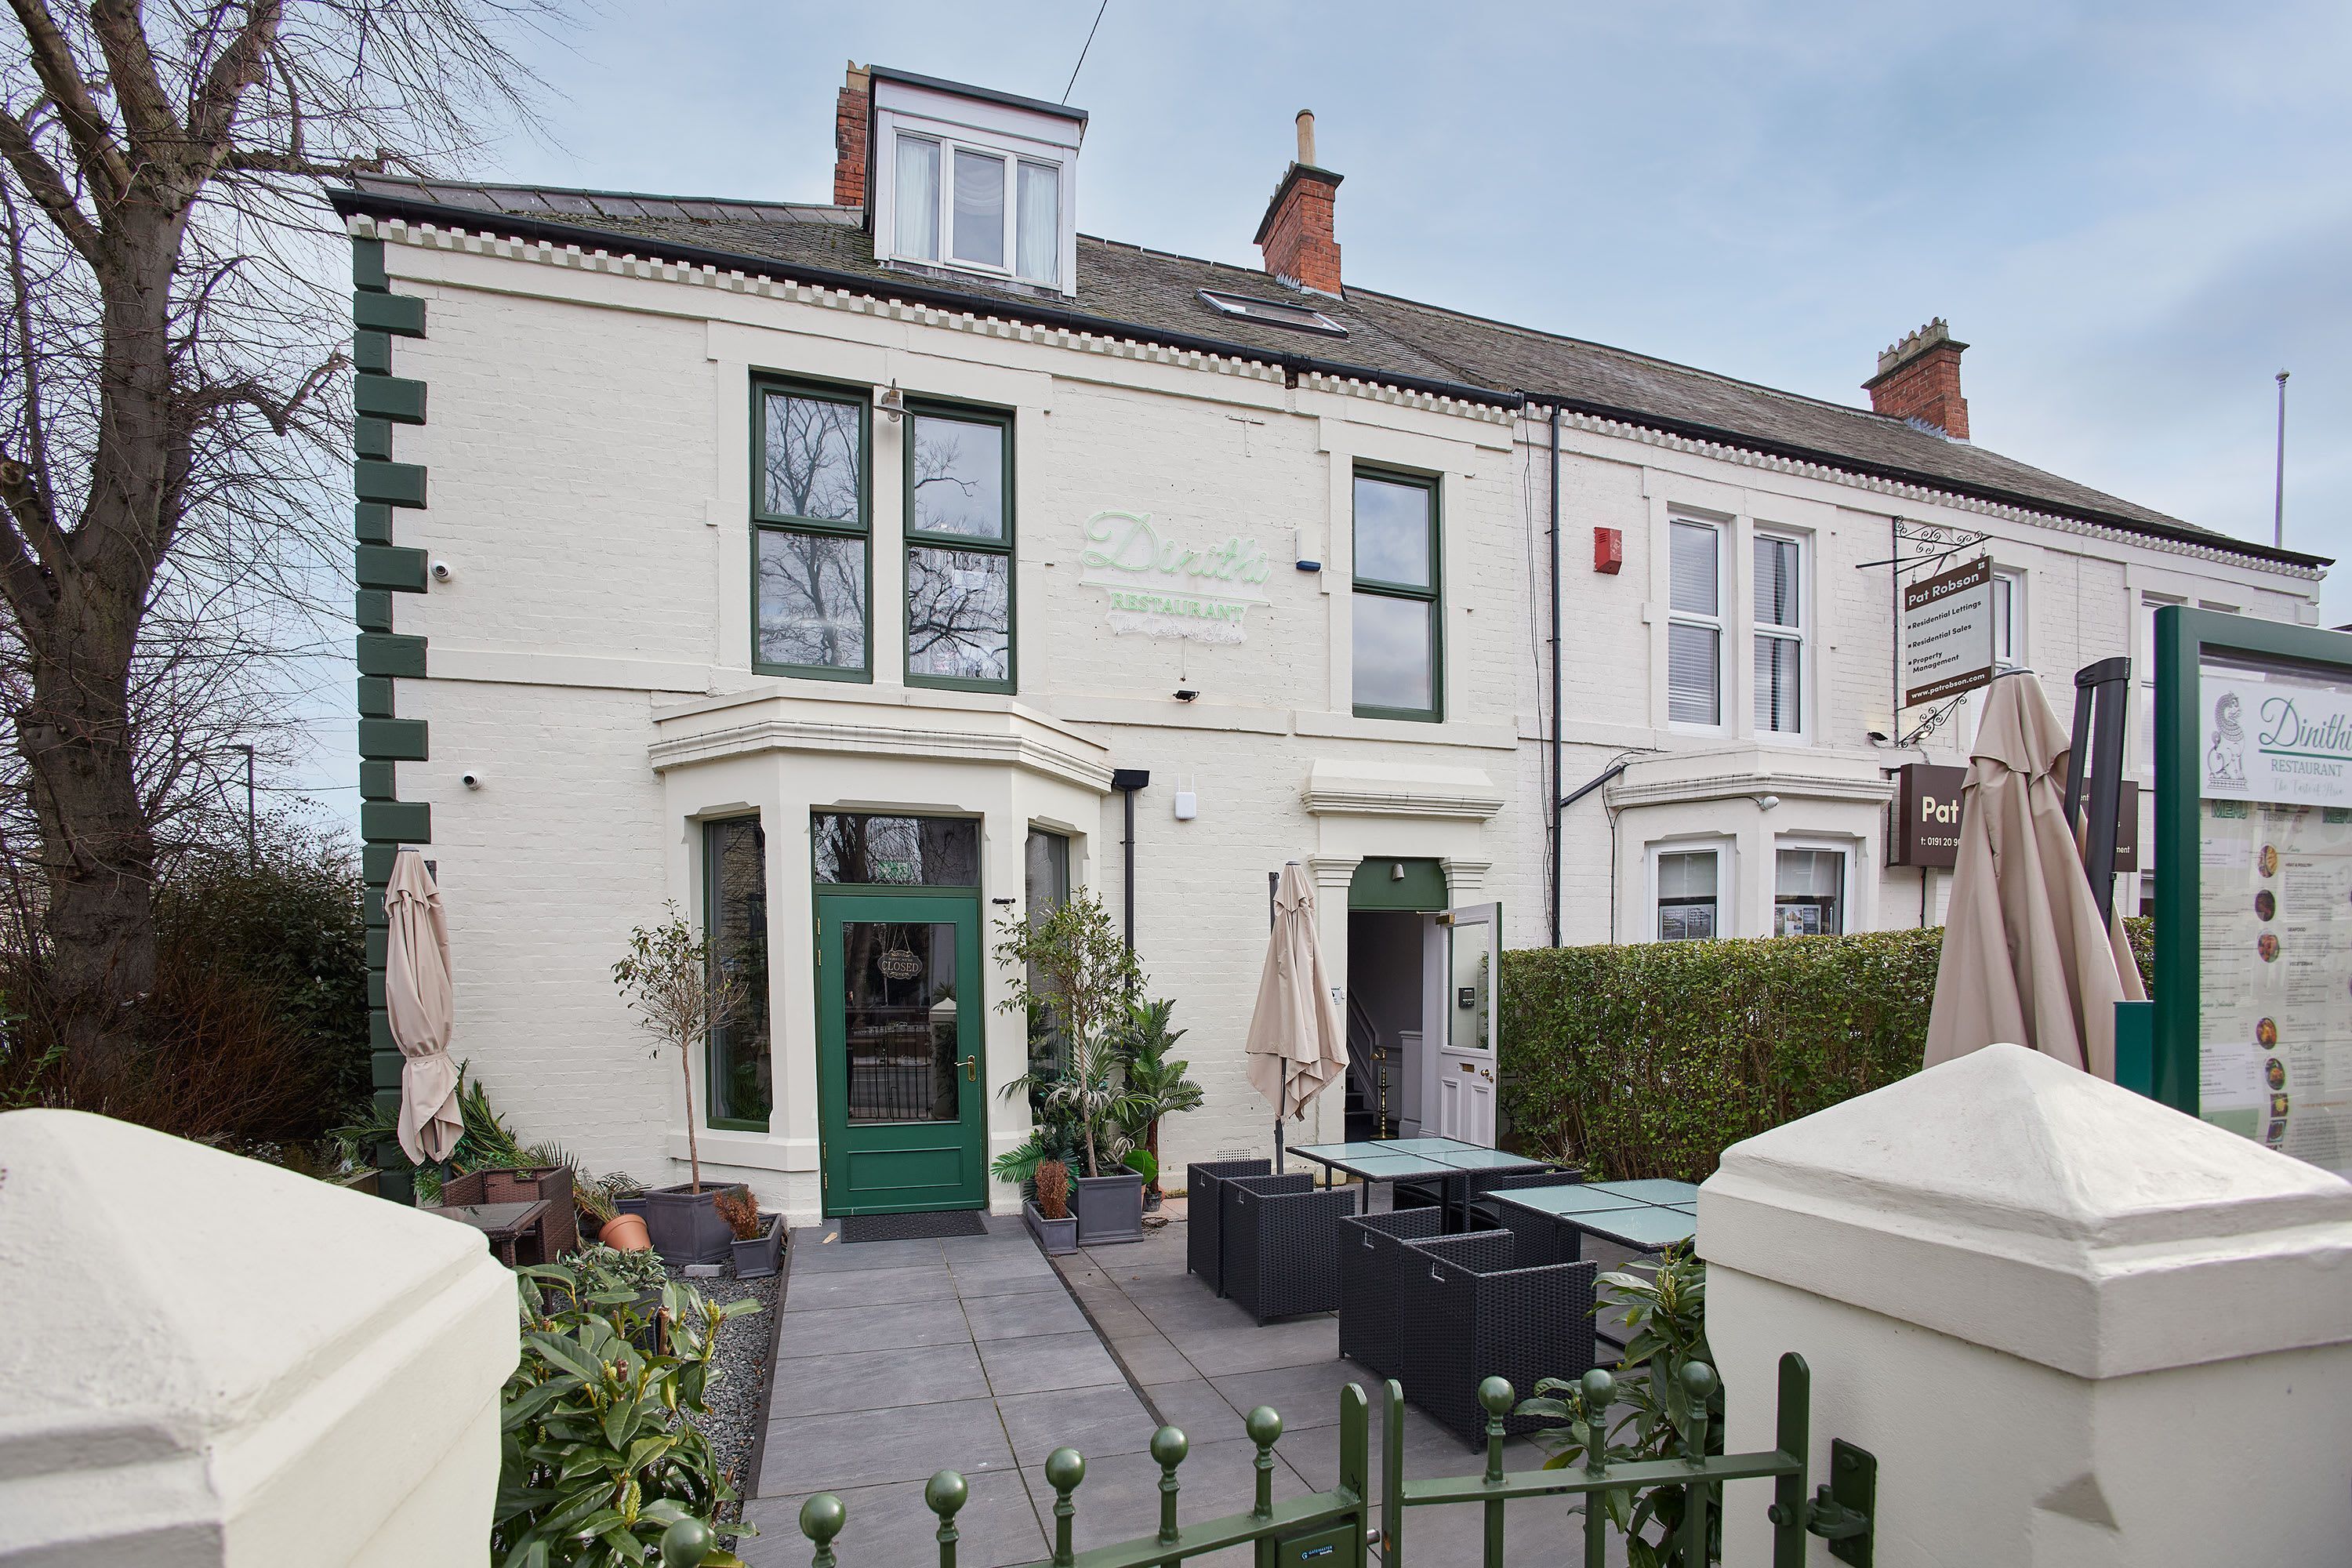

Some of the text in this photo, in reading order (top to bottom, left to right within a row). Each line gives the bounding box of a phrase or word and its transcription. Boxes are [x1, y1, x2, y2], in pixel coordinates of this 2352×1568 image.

[1080, 511, 1270, 584] Dinithi
[1908, 573, 1980, 606] Pat Robson
[1111, 592, 1245, 622] RESTAURANT
[1912, 601, 1982, 629] Residential Lettings
[1912, 624, 1972, 648] Residential Sales
[1912, 651, 1943, 665] Property
[1912, 654, 1959, 673] Management
[1911, 673, 1985, 699] www.patrobson.com
[2270, 758, 2343, 777] RESTAURANT
[1922, 796, 1959, 824] Pat
[2211, 799, 2248, 819] MENU
[2321, 807, 2352, 824] MEN
[1921, 837, 1926, 845] t:
[1927, 837, 1942, 846] 0191
[1943, 837, 1952, 847] 20
[881, 960, 919, 972] CLOSED
